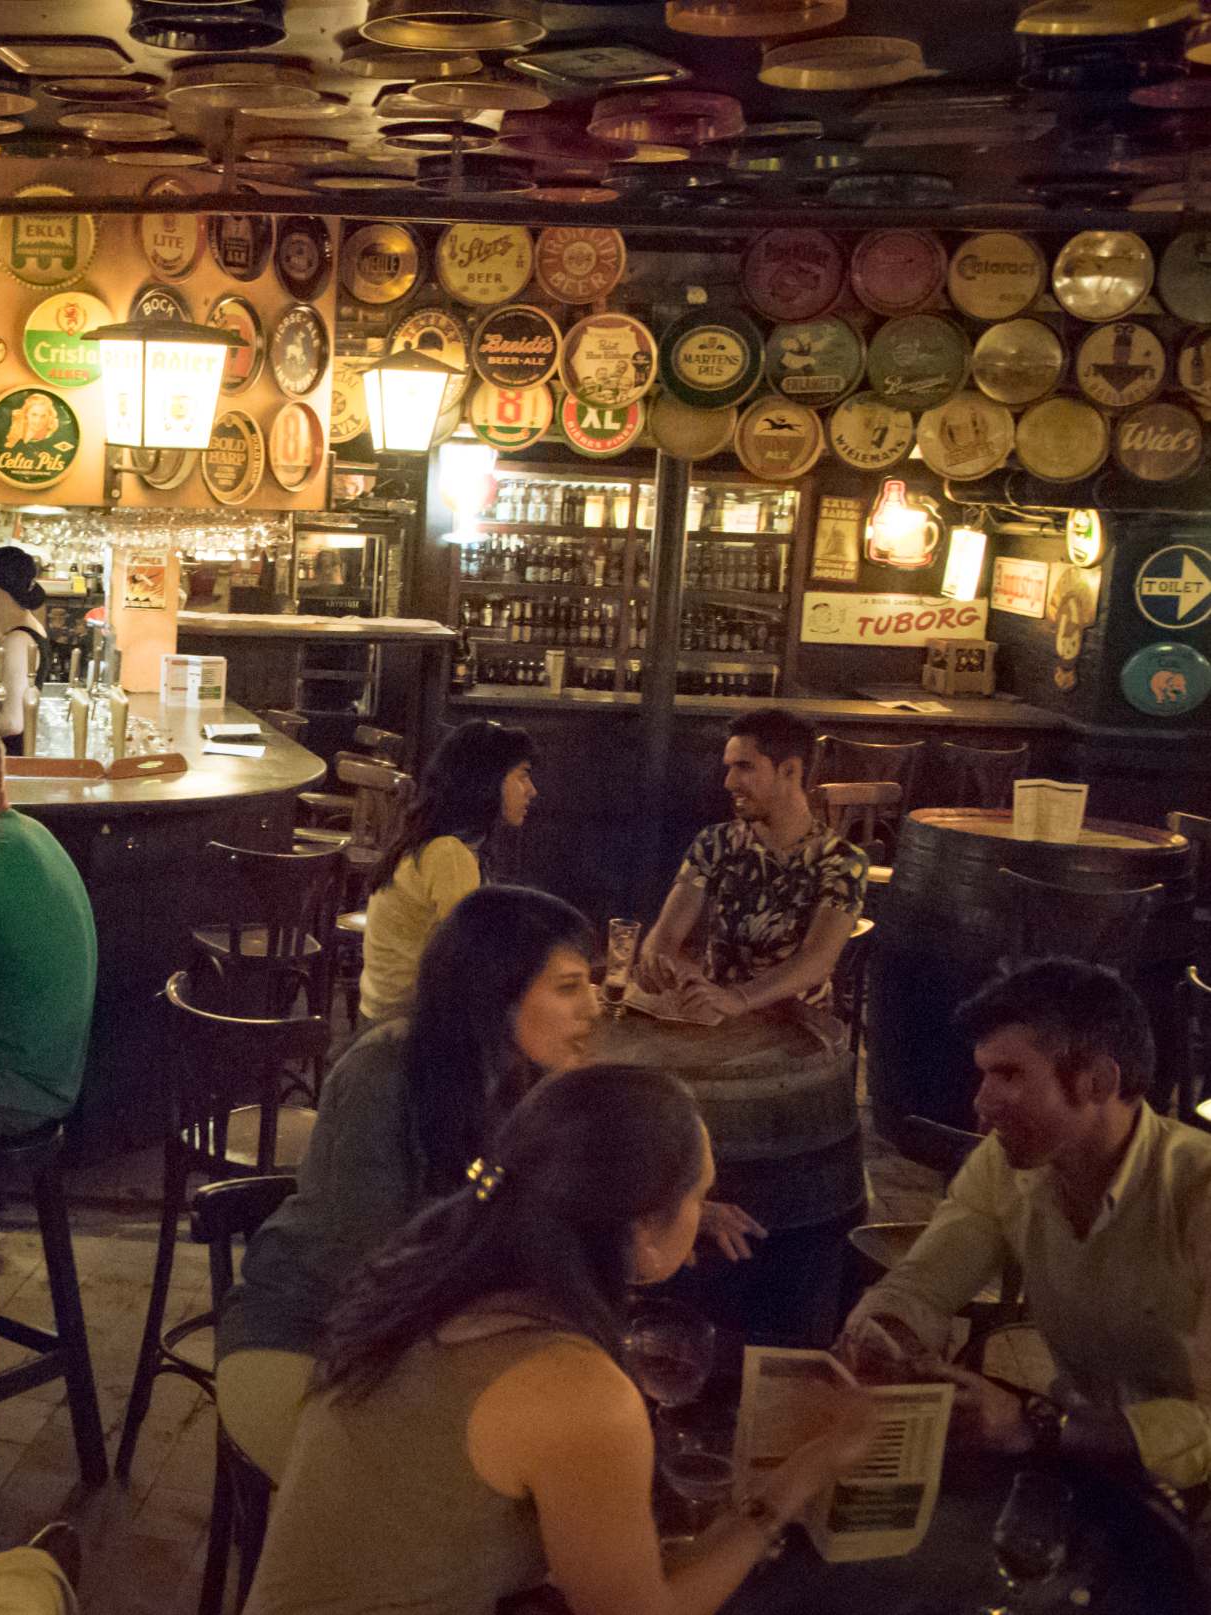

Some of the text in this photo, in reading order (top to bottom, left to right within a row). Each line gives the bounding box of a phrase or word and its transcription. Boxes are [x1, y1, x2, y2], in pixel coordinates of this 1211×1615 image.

[25, 224, 66, 238] EKLA
[153, 233, 185, 249] LITE
[466, 272, 504, 284] BEER
[549, 270, 608, 296] BEER
[142, 297, 176, 318] BOCK
[33, 339, 100, 365] Crista
[682, 353, 741, 366] MARTENS
[835, 434, 906, 464] WIELEMANS
[35, 451, 66, 471] Pils
[1144, 580, 1205, 593] TOILET
[857, 606, 981, 637] TUBORG
